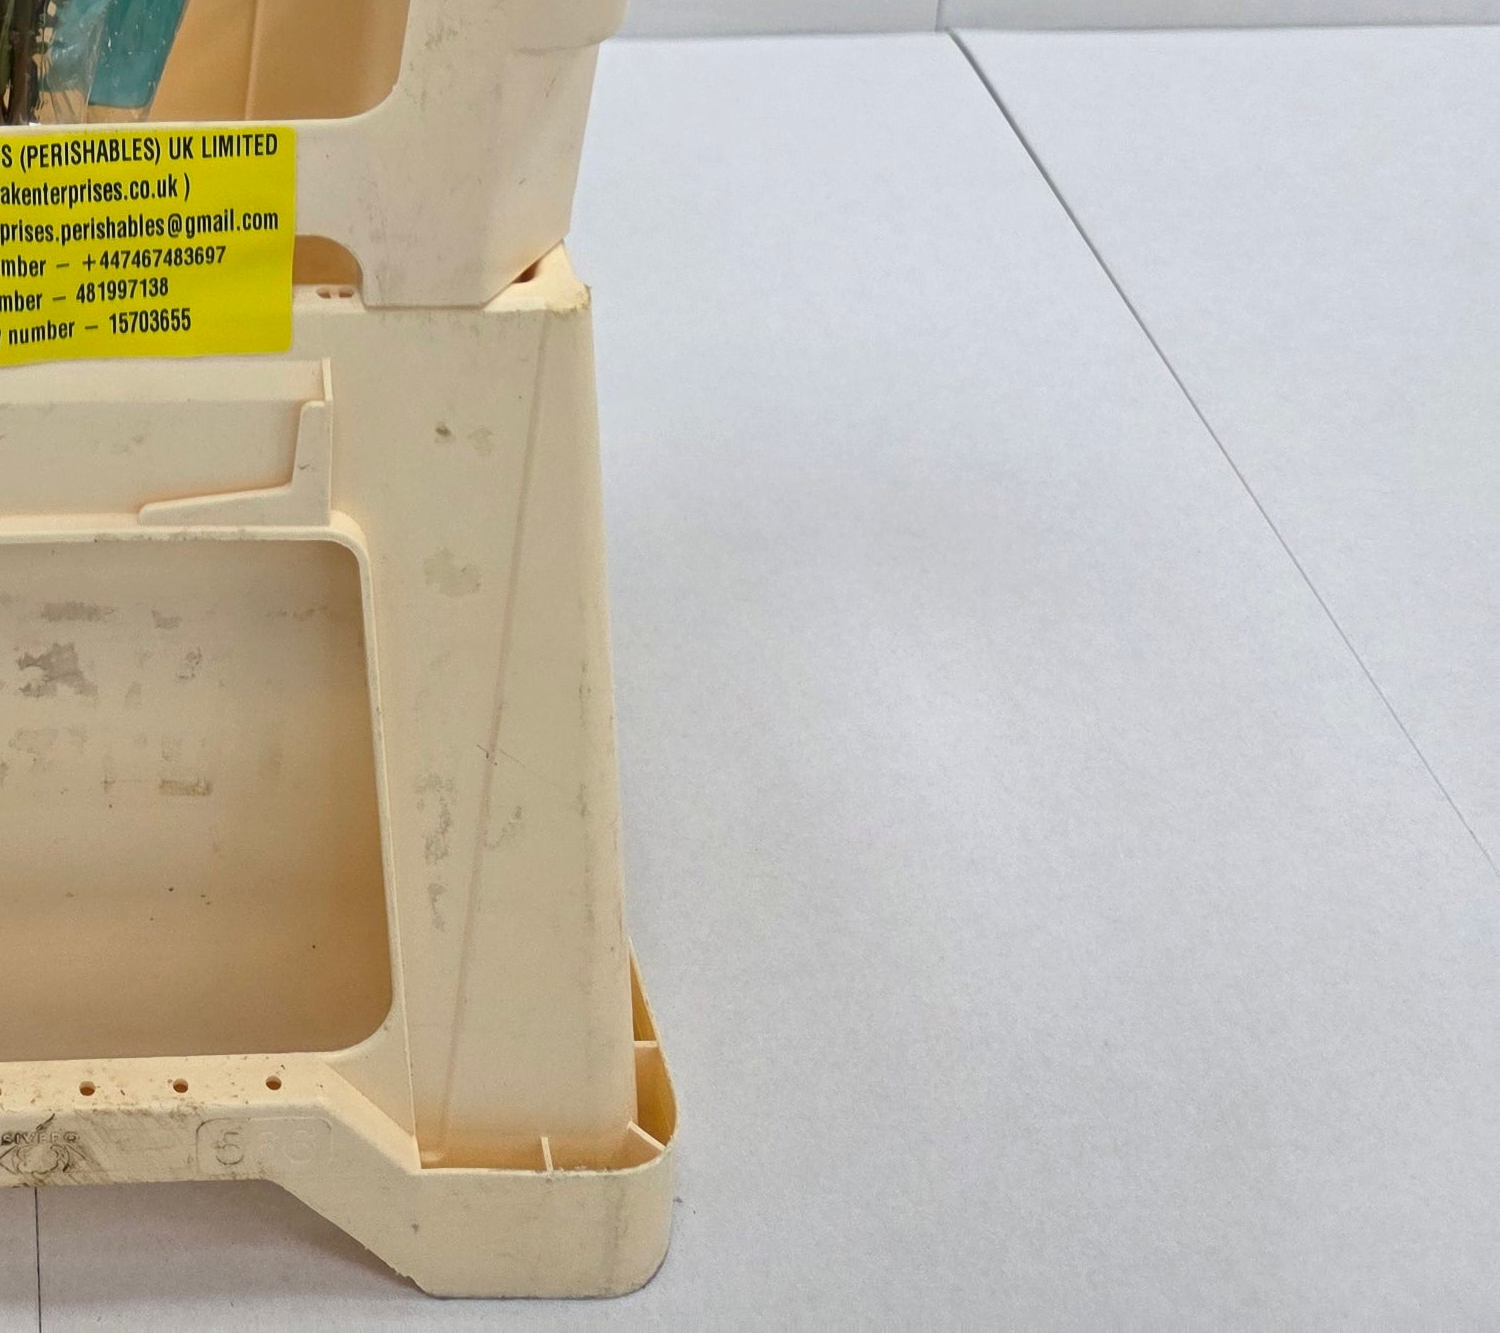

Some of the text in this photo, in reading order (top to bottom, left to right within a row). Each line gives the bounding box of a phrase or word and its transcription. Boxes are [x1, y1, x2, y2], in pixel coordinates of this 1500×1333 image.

[20, 137, 160, 173] (PERISHABLES)
[169, 136, 193, 160] UK
[202, 133, 277, 158] LIMITED
[76, 277, 168, 303] 481997138
[9, 321, 75, 345] number
[109, 308, 191, 334] 15703655
